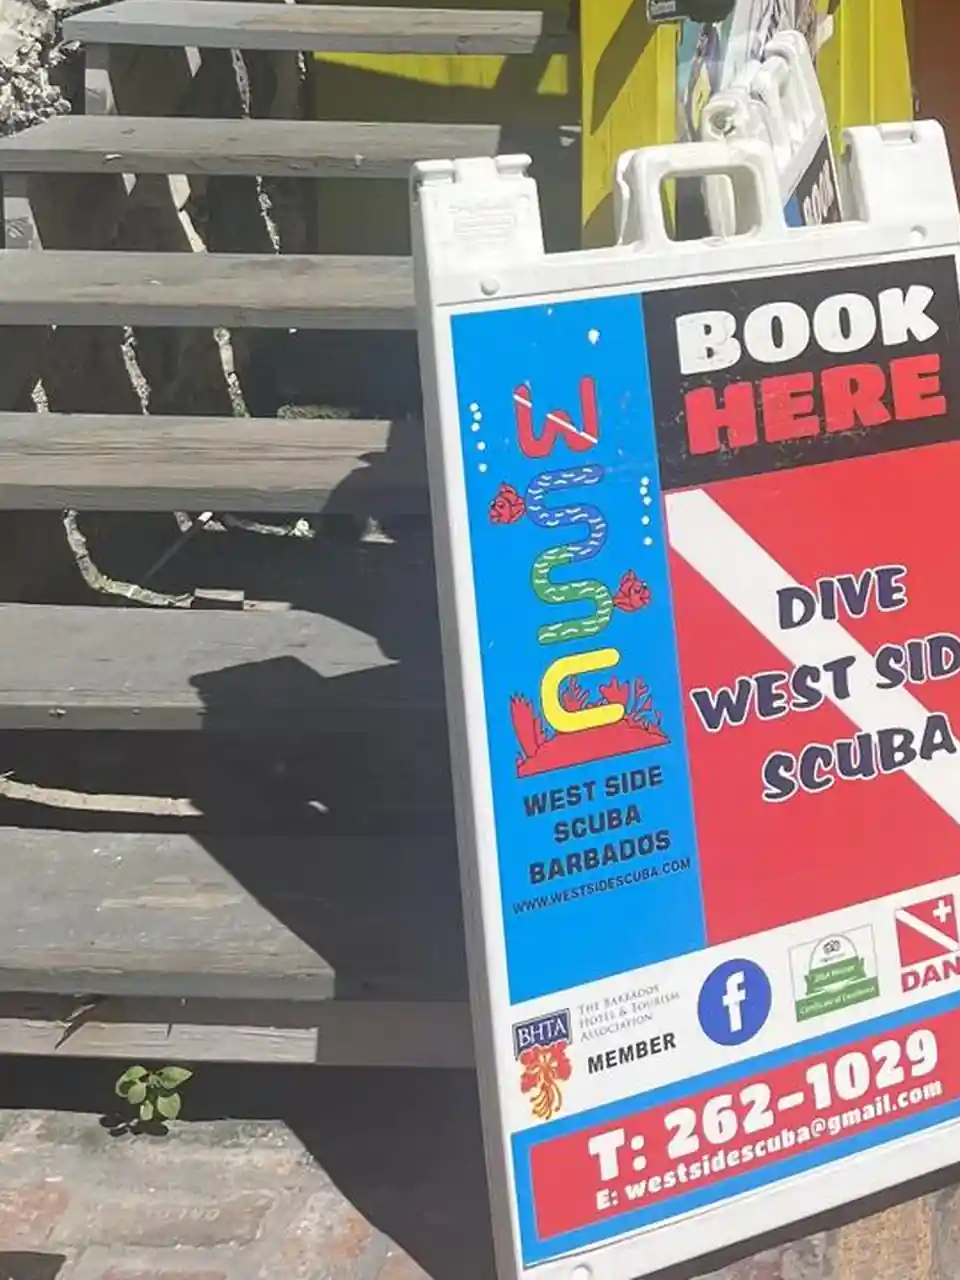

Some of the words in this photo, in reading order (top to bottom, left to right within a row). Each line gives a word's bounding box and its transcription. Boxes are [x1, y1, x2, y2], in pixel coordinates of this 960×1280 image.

[676, 285, 939, 375] BOOK
[685, 354, 946, 455] HERE
[775, 566, 907, 631] DIVE
[691, 655, 856, 732] WEST
[762, 713, 958, 802] SCUBA
[523, 780, 596, 817] WEST
[605, 765, 664, 797] SIDE
[554, 804, 641, 844] SCUBA
[513, 858, 691, 915] WWW.WESTSIDESCUBA.COM
[529, 829, 672, 885] BARBADOS
[518, 1018, 567, 1047] BHTA
[587, 1032, 677, 1074] MEMBER
[588, 1129, 647, 1183] T:
[664, 1028, 940, 1161] 262-1029
[596, 1186, 619, 1211] E:
[624, 1080, 943, 1200] westsidescuba@gmail.com
